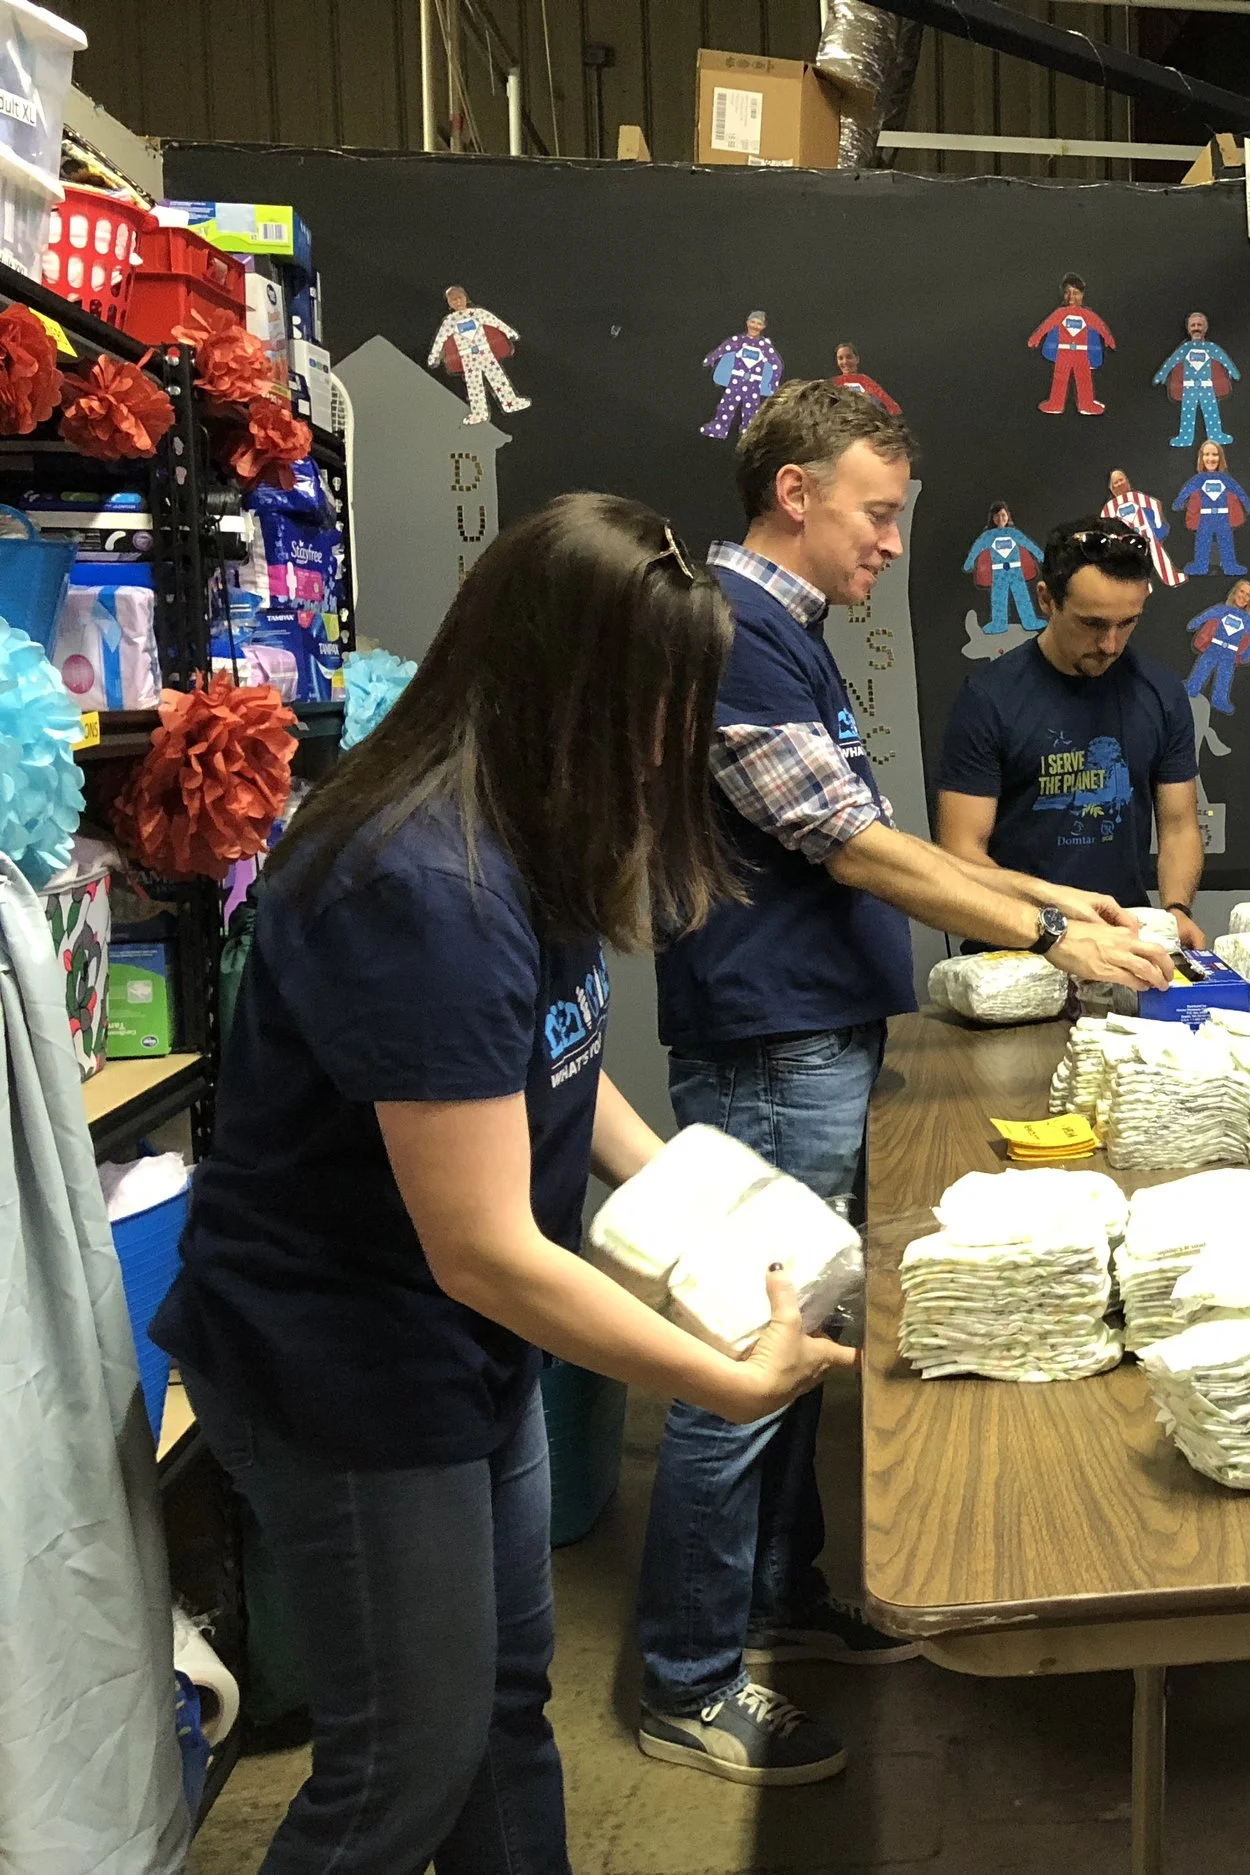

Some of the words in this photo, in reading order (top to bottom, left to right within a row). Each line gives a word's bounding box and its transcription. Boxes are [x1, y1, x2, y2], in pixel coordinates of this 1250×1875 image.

[23, 103, 35, 124] XL
[291, 540, 323, 564] Stayfree
[266, 614, 295, 622] TAMPAX
[318, 642, 339, 656] TAMPAX
[1041, 755, 1045, 775] I
[1048, 751, 1085, 774] SERVE
[1039, 776, 1062, 795] THE
[1063, 769, 1105, 794] PLANET
[1057, 836, 1095, 846] Domtar
